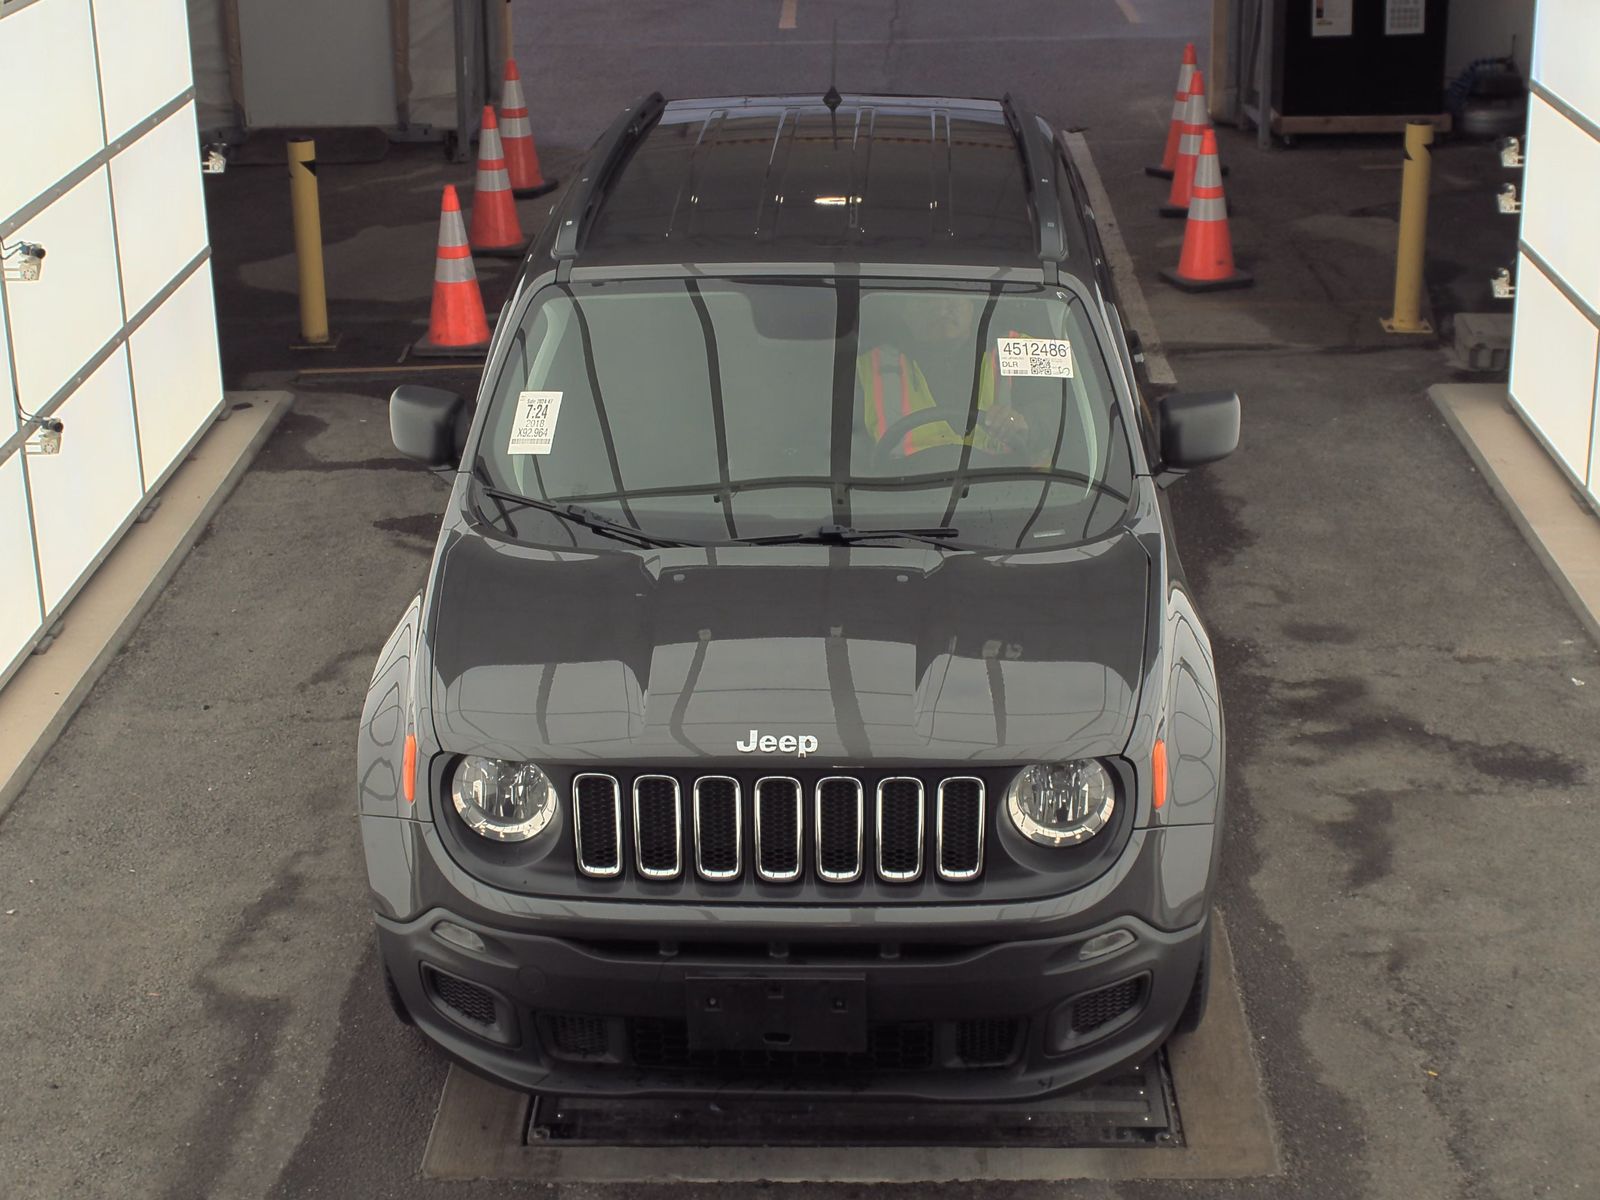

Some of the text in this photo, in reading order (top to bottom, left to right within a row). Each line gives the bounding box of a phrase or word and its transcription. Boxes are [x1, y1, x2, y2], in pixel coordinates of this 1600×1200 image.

[1003, 343, 1067, 357] 4512486
[526, 404, 549, 419] 7:24
[736, 729, 818, 758] Jeep
